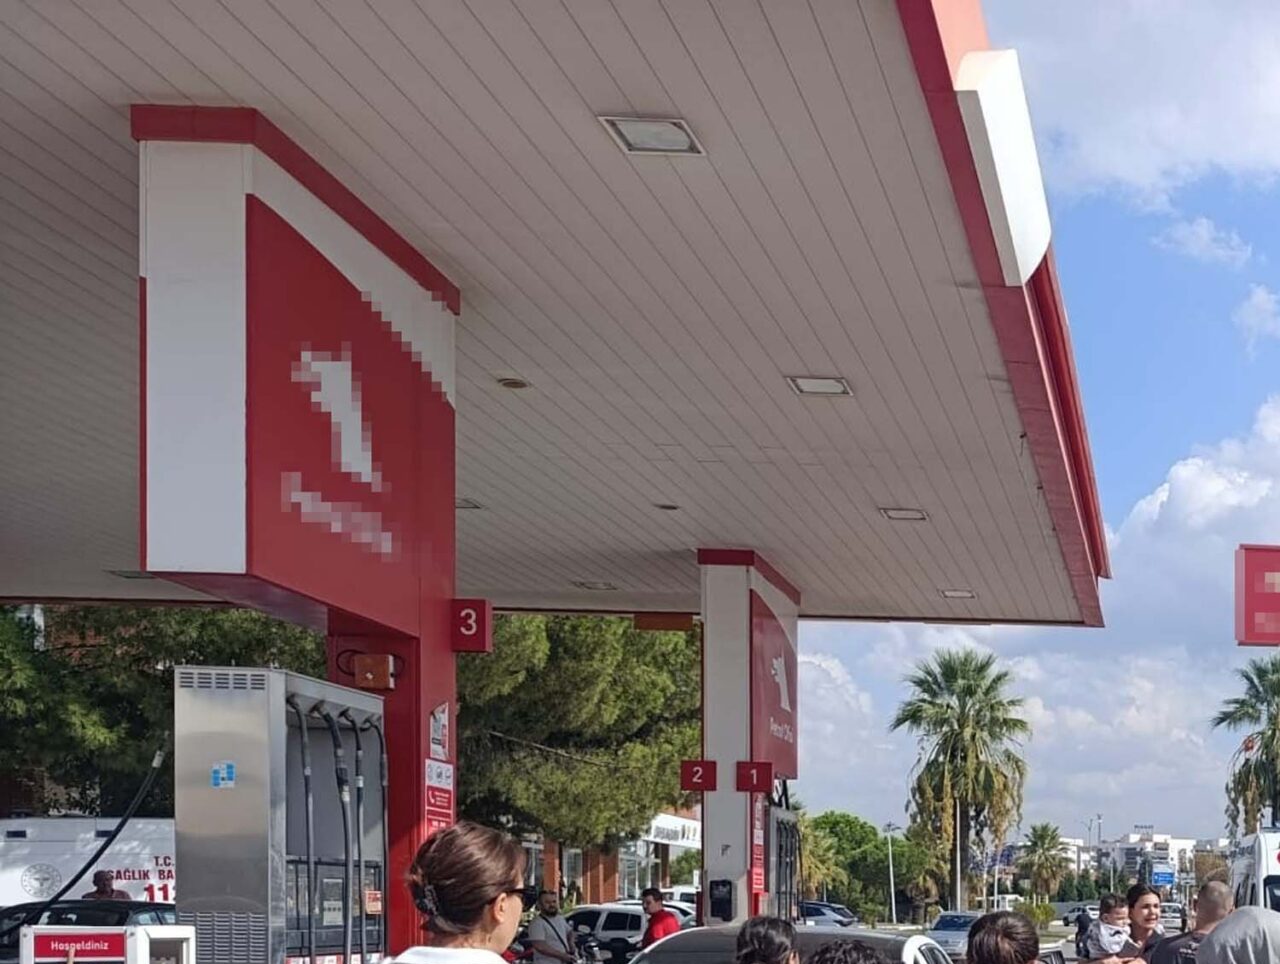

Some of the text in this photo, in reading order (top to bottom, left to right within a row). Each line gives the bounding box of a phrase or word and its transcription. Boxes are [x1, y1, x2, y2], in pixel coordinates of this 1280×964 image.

[460, 608, 478, 635] 3
[692, 766, 703, 783] 2
[750, 768, 757, 785] 1
[154, 856, 175, 867] T.C.
[144, 884, 176, 903] 11
